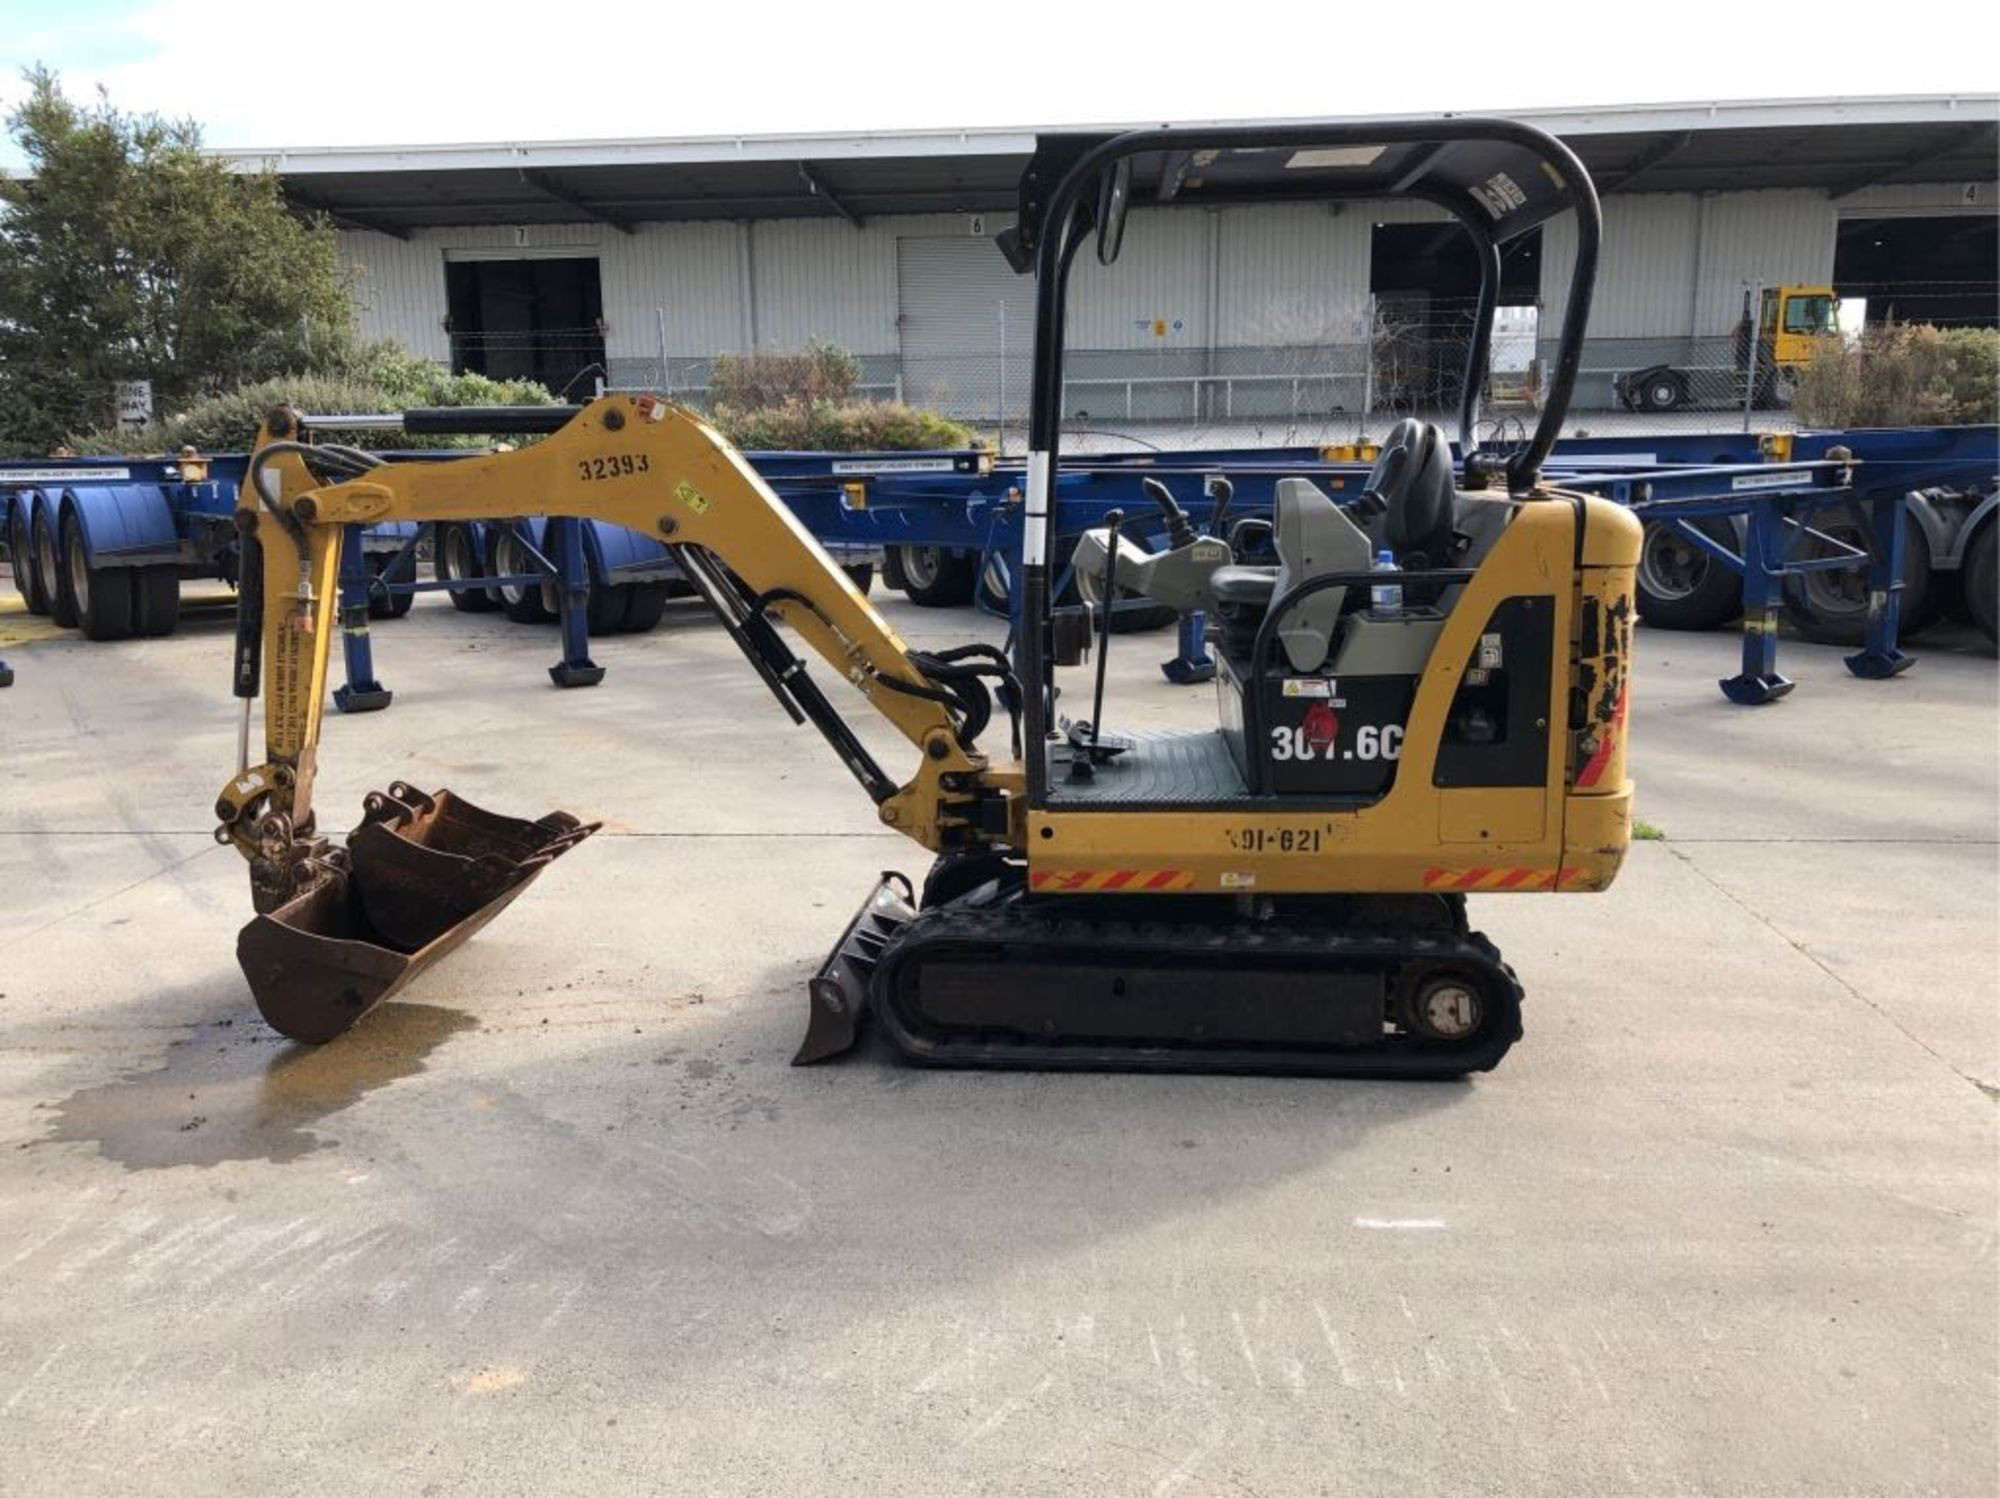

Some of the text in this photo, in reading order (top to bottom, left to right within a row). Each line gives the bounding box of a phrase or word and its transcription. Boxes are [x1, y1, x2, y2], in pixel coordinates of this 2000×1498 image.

[1966, 184, 1976, 201] 4
[974, 218, 981, 233] 6
[517, 228, 525, 244] 7
[578, 454, 649, 480] 32393
